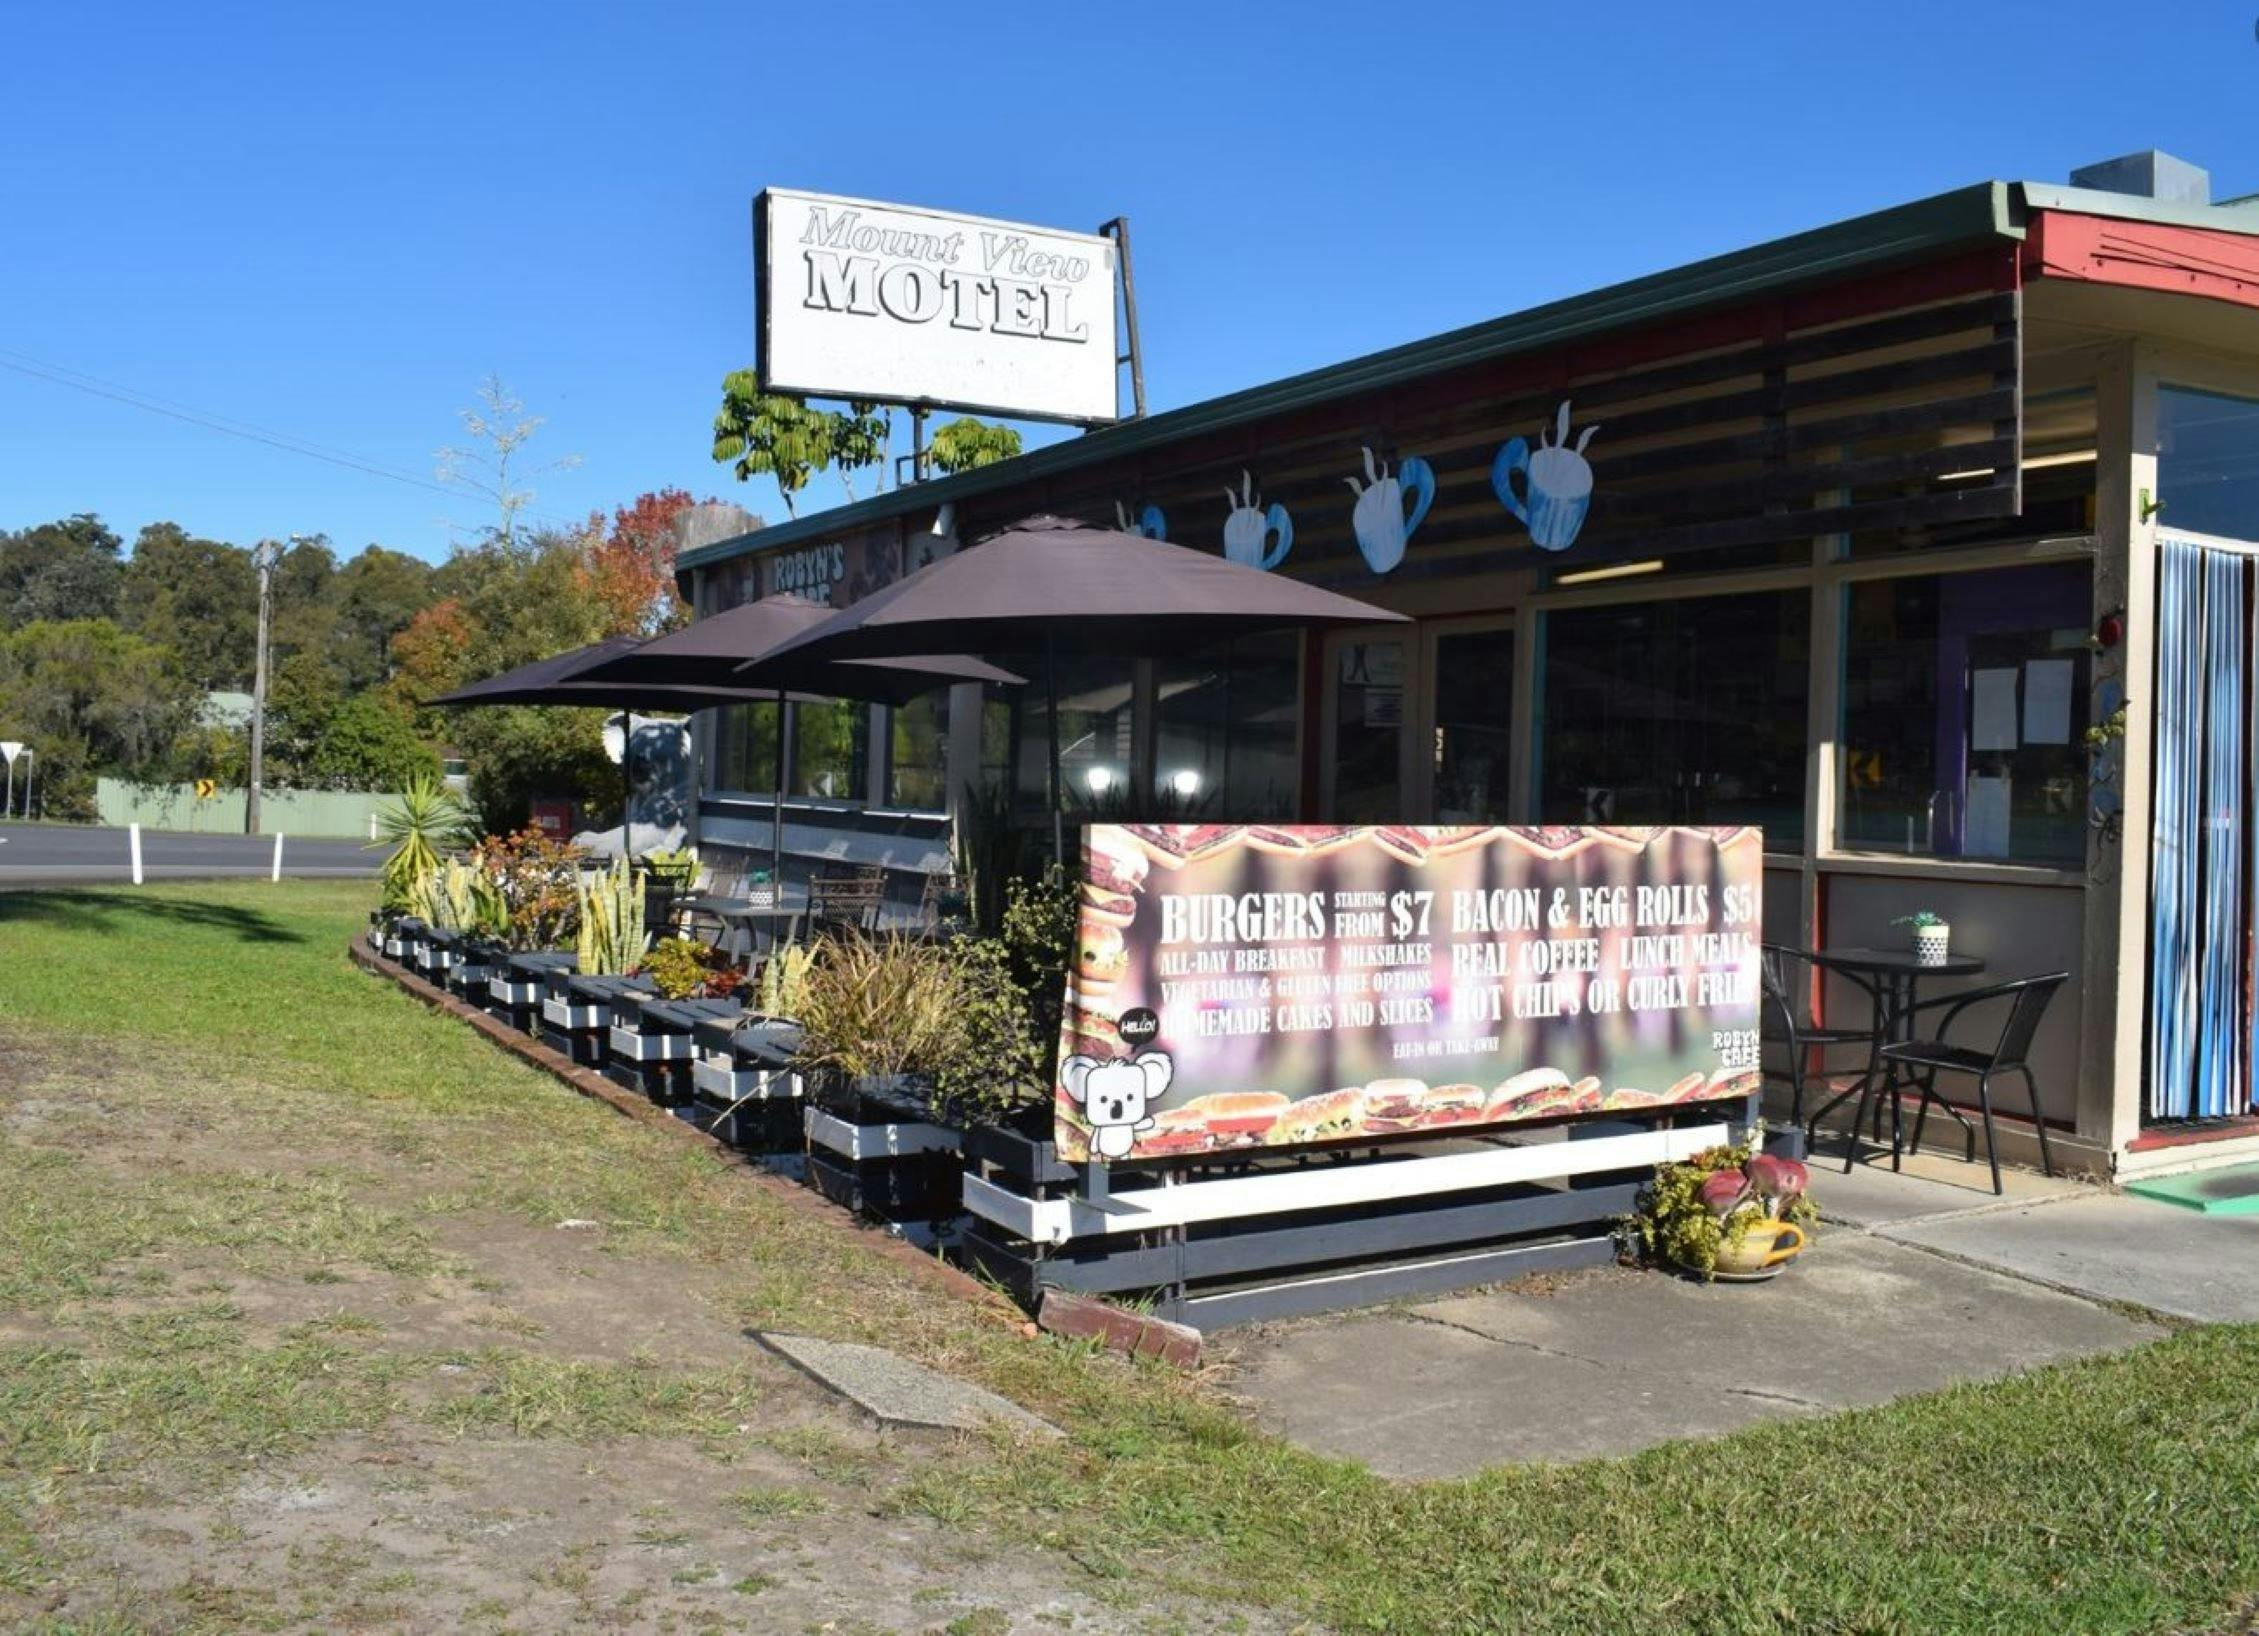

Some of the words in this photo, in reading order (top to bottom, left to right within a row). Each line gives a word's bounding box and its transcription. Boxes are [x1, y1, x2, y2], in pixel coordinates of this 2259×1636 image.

[799, 206, 964, 263] Mount
[979, 231, 1089, 282] View
[803, 250, 1088, 343] MOTEL
[774, 543, 844, 591] ROBYN'S
[1159, 891, 1326, 944] BURGERS
[1334, 891, 1386, 908] STARTING
[1390, 890, 1435, 941] $7
[1451, 888, 1540, 933] BACON
[1548, 886, 1571, 930] &
[1579, 886, 1629, 929] EGG
[1636, 884, 1710, 927] ROLLS
[1723, 885, 1752, 925] $5
[1334, 912, 1386, 939] FROM
[1159, 951, 1229, 977] ALL-DAY
[1234, 946, 1326, 974] BREAKFAST
[1339, 943, 1432, 967] MILKSHAKES
[1451, 940, 1511, 978] REAL
[1518, 937, 1600, 975] COFFEE
[1620, 934, 1685, 970] LUNCH
[1692, 930, 1755, 966] MEALS
[1260, 976, 1271, 999] &
[1372, 969, 1433, 993] OPTIONS
[1452, 984, 1505, 1023] HOT
[1512, 979, 1581, 1018] CHIPS
[1587, 977, 1621, 1014] OR
[1627, 974, 1690, 1010] CURLY
[1697, 970, 1755, 1007] FRI
[1159, 1007, 1271, 1038] HMEMADE
[1276, 1002, 1333, 1033] CAKES
[1338, 1000, 1375, 1029] AND
[1380, 996, 1434, 1027] SLICES
[1721, 1047, 1760, 1069] CAFE
